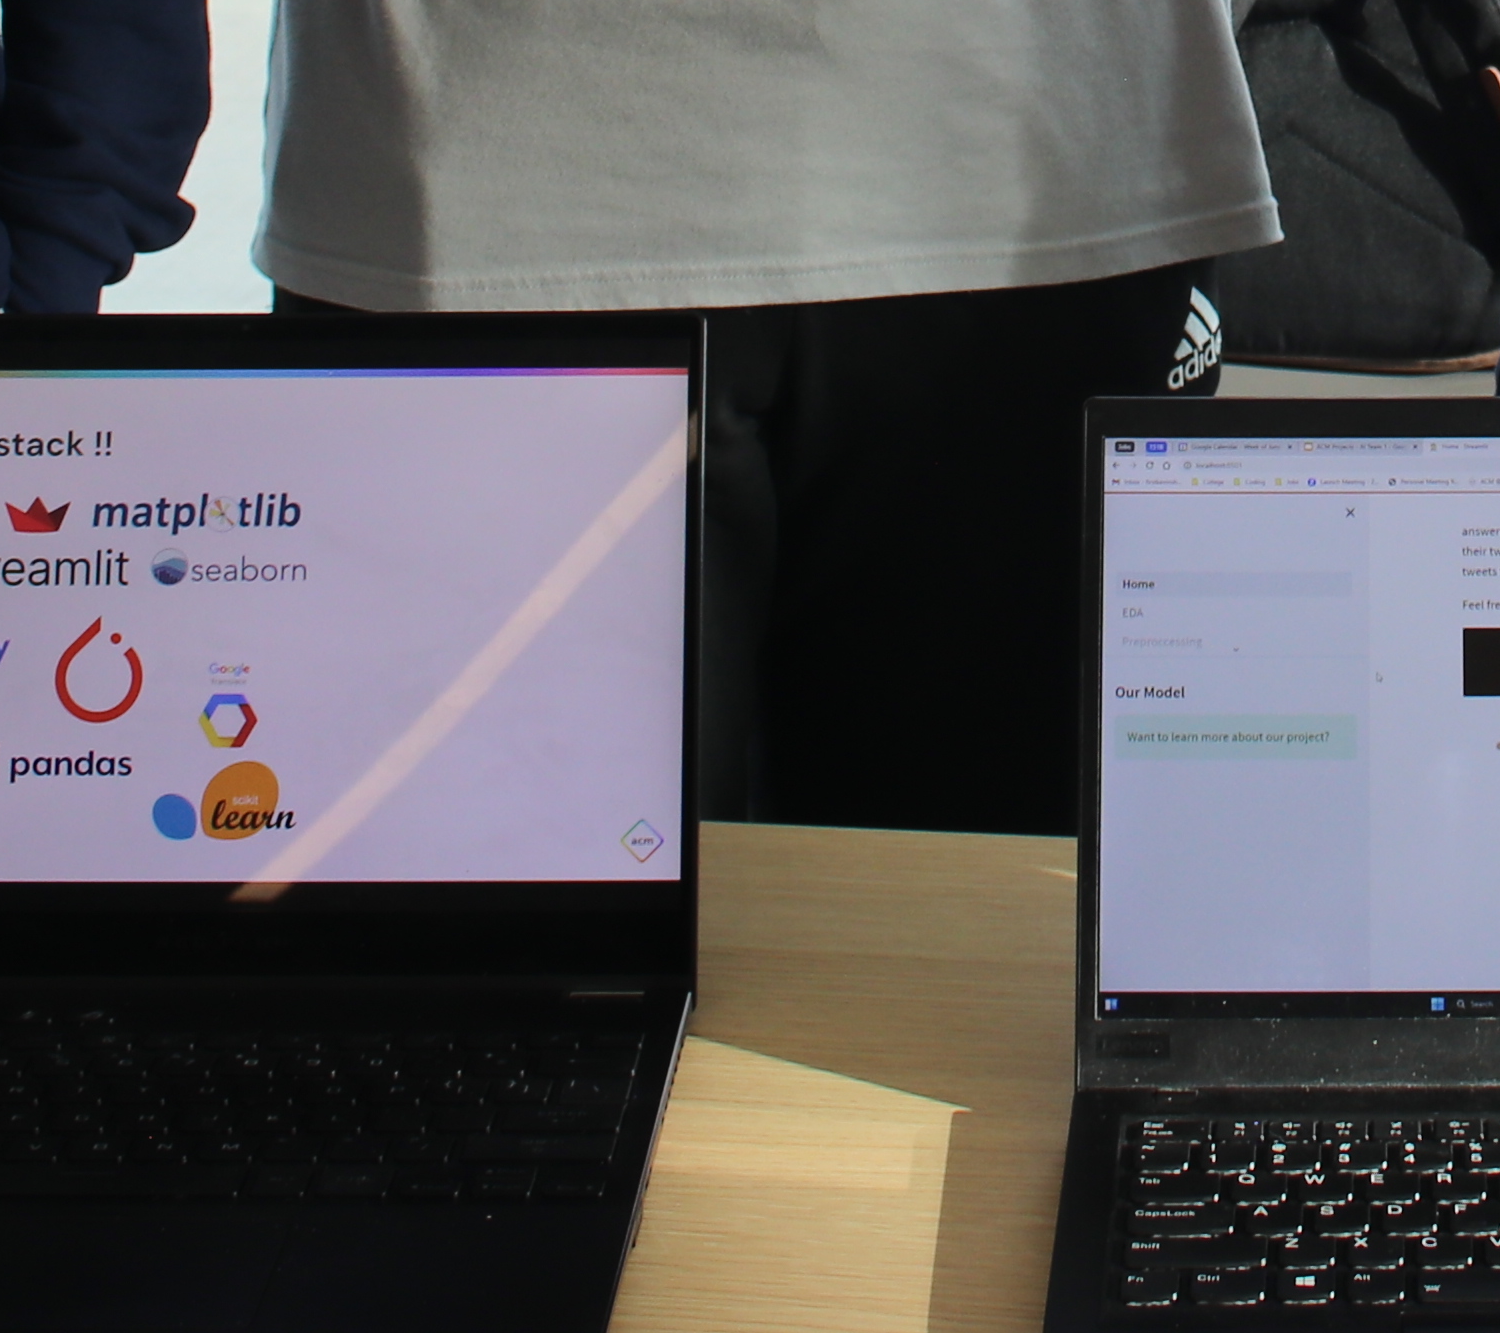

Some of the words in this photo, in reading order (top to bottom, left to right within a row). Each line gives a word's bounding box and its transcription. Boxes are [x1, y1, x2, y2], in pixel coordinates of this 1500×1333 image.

[1167, 328, 1222, 390] adid
[95, 431, 113, 456] !!
[1462, 546, 1487, 557] their
[191, 554, 307, 582] seaborn
[1462, 566, 1497, 577] tweets
[1123, 579, 1155, 589] Home
[1463, 600, 1484, 611] Feel
[1122, 608, 1143, 618] EDA
[209, 662, 250, 677] Google
[1115, 686, 1140, 698] Our
[1144, 686, 1185, 698] Model
[1128, 732, 1154, 742] Want
[1157, 732, 1168, 742] to
[1172, 732, 1198, 742] learn
[1201, 734, 1228, 742] more
[1232, 732, 1262, 742] about
[1266, 734, 1283, 742] our
[1287, 732, 1329, 744] project?
[10, 750, 132, 783] pandas
[211, 799, 296, 830] learn
[1238, 1174, 1255, 1184] Q
[1304, 1174, 1325, 1184] W
[1371, 1173, 1384, 1183] E
